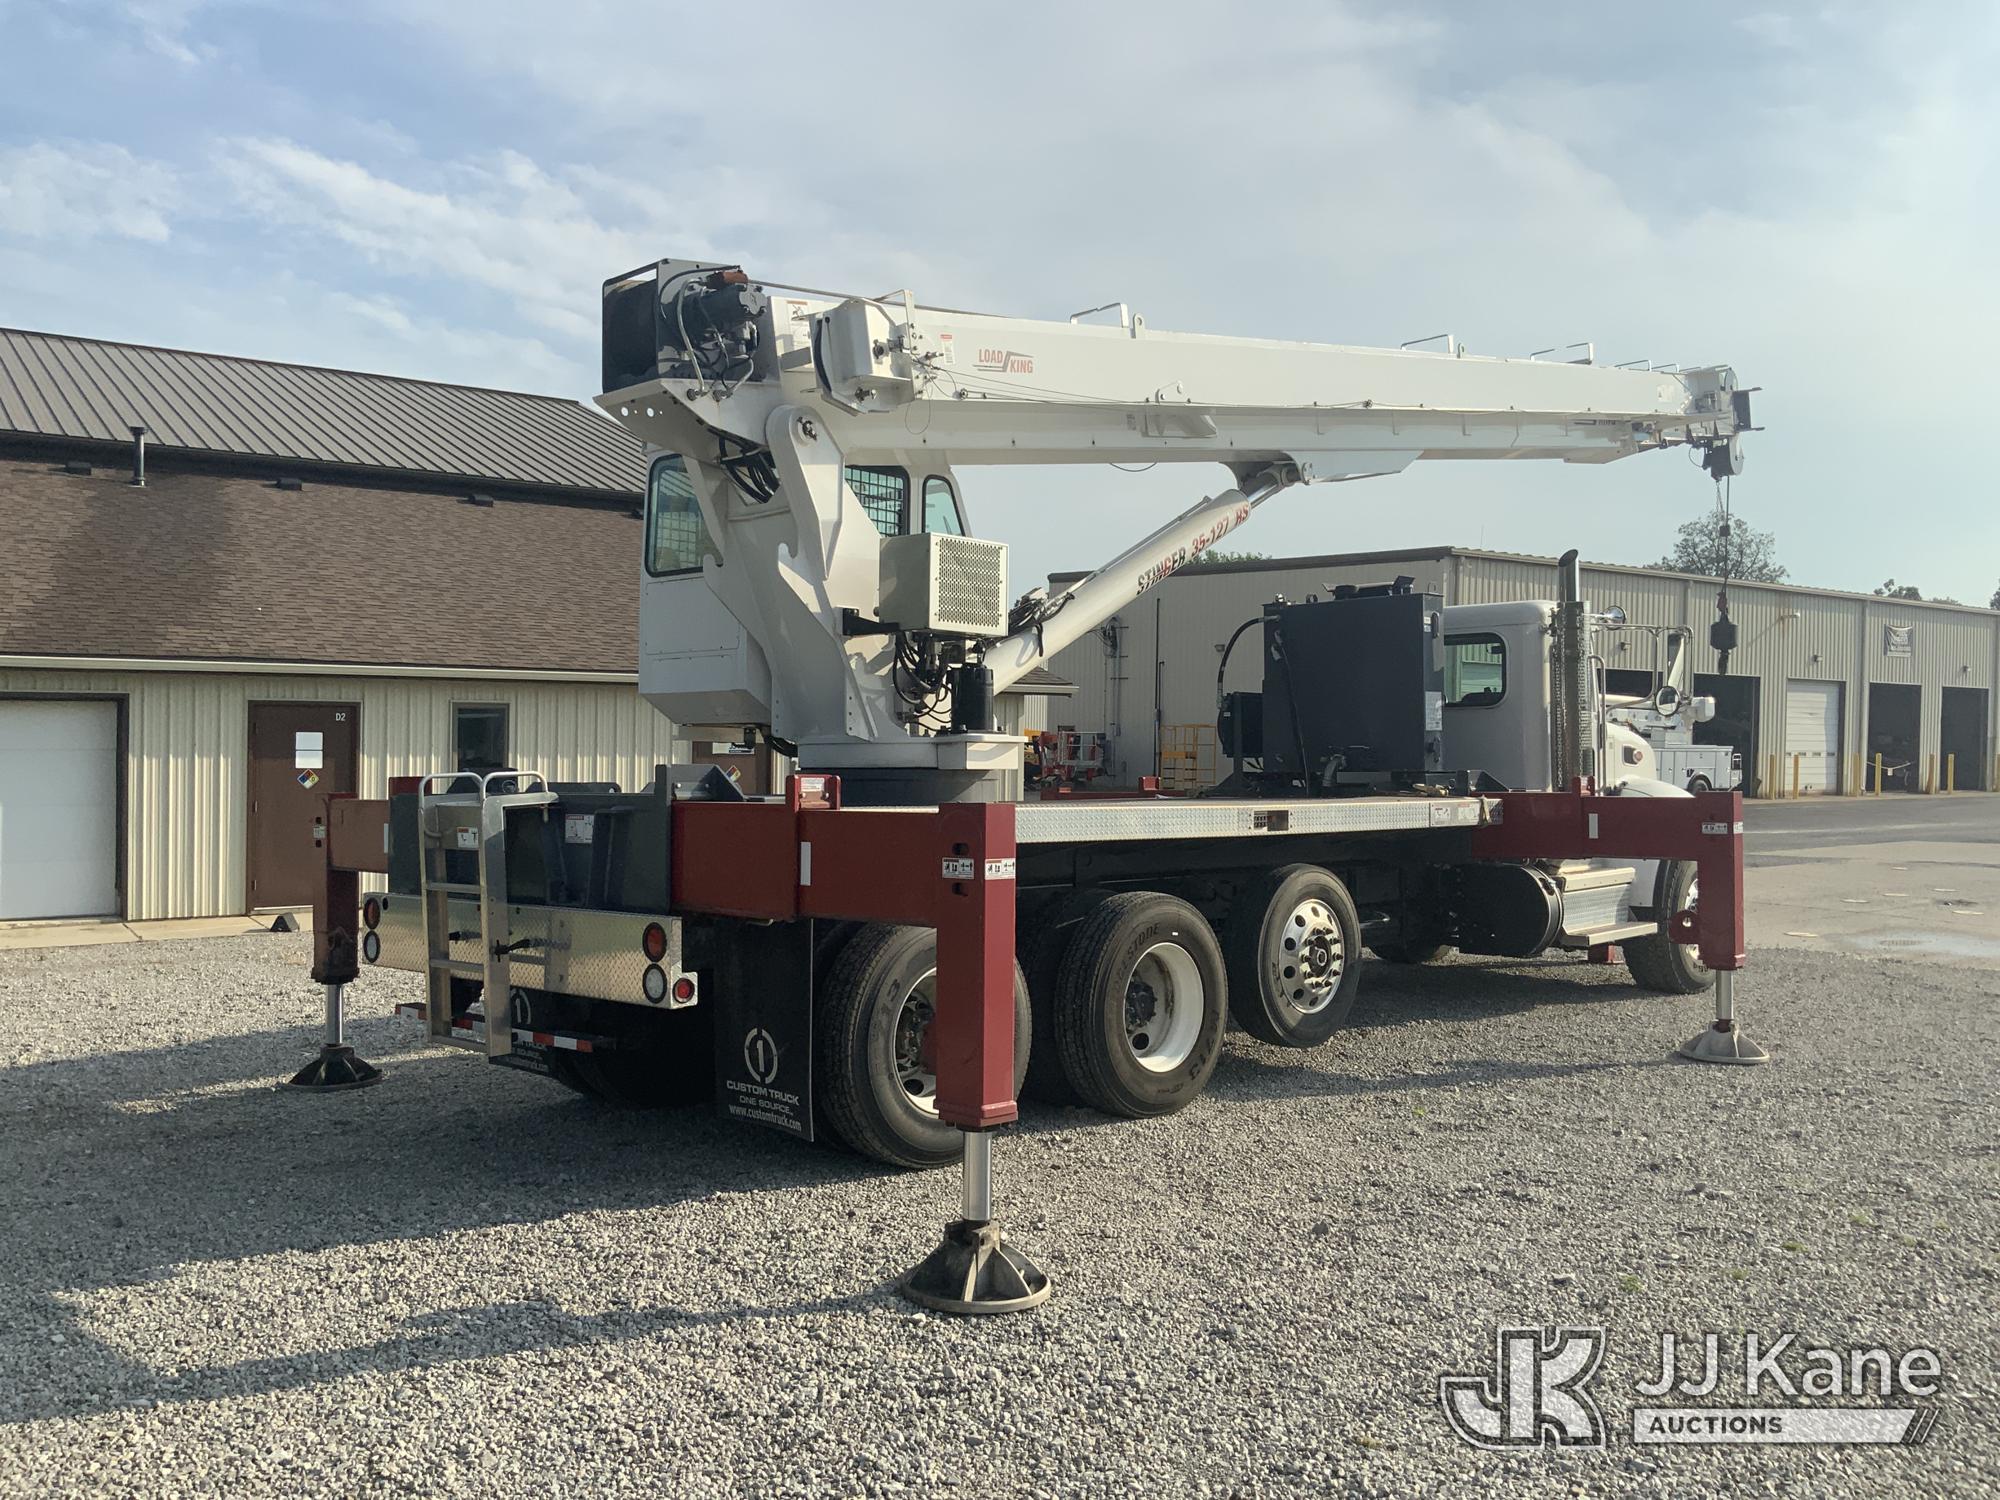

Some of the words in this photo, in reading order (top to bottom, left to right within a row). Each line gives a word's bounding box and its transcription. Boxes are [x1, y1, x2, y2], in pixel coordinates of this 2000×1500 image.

[979, 349, 1003, 363] LOAD
[1010, 359, 1033, 373] KING
[1137, 546, 1186, 595] STINGER
[1191, 515, 1229, 558] 35-127
[336, 713, 345, 721] D2
[727, 1080, 768, 1096] CUSTOM
[769, 1089, 800, 1106] TRUCK
[740, 1096, 757, 1106] ONE
[729, 1104, 802, 1132] www.customtruck.com
